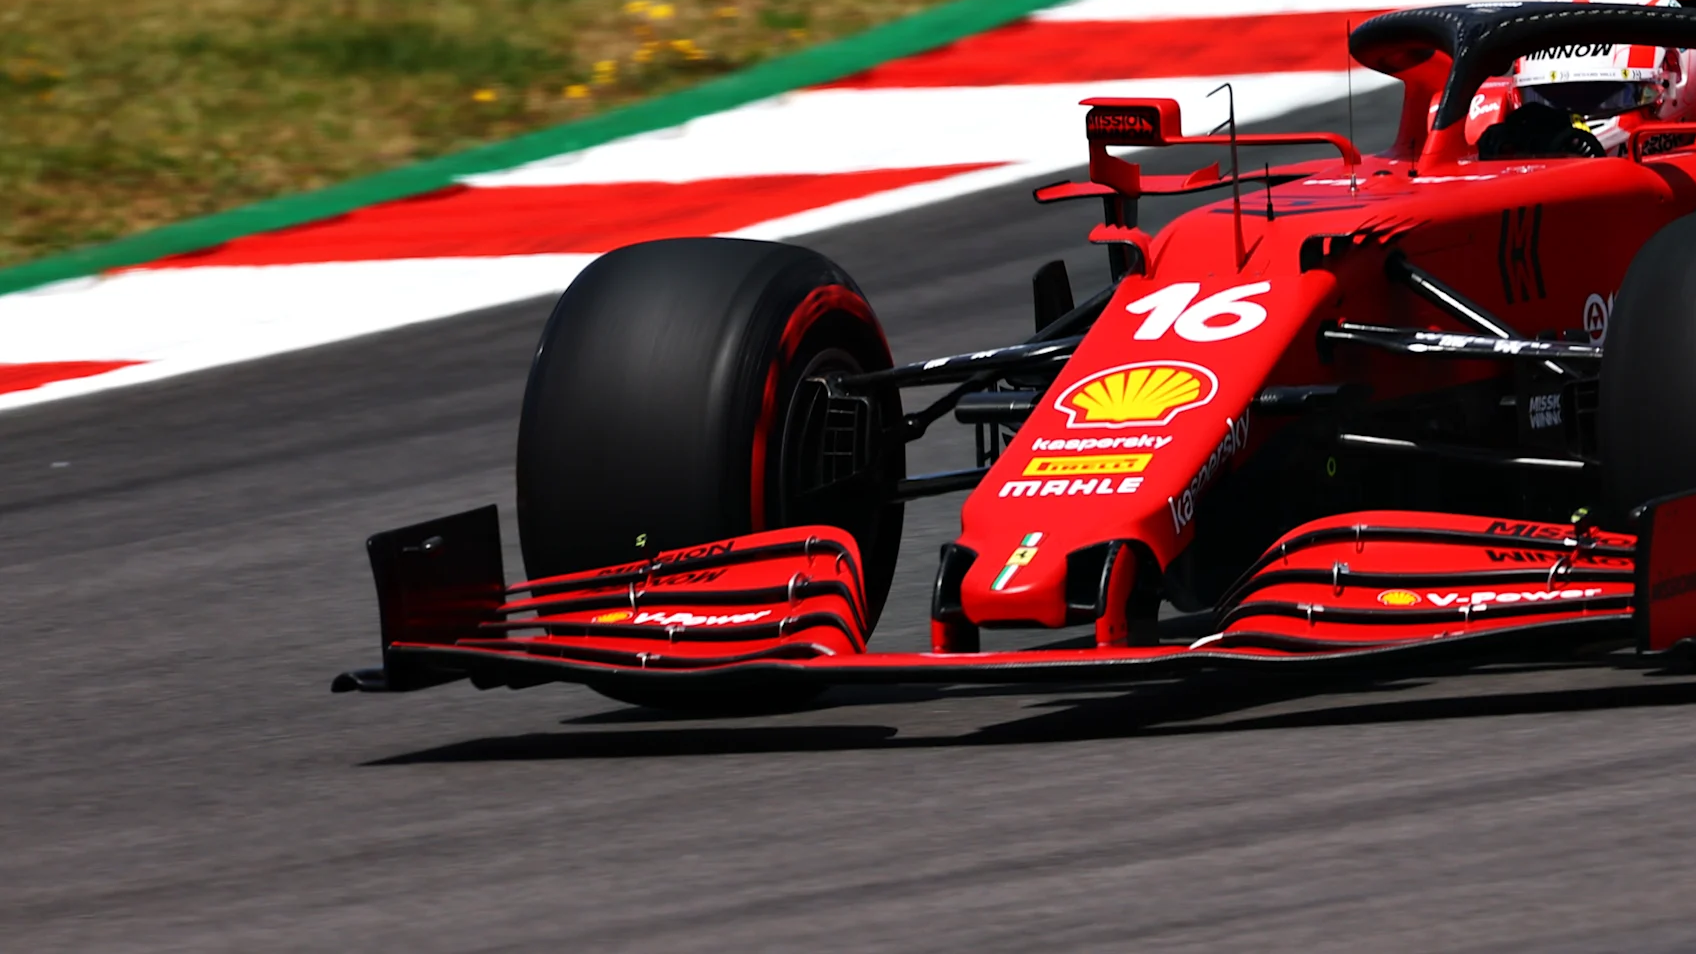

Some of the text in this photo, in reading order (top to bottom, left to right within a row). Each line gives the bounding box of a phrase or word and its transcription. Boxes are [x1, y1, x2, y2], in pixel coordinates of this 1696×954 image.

[1525, 43, 1614, 62] INNOW
[1124, 281, 1272, 343] 16
[1528, 409, 1564, 431] WINN
[1031, 433, 1173, 452] kaspersky
[998, 476, 1145, 498] MAHLE
[1426, 587, 1602, 607] V-Power
[634, 609, 772, 626] V-Power
